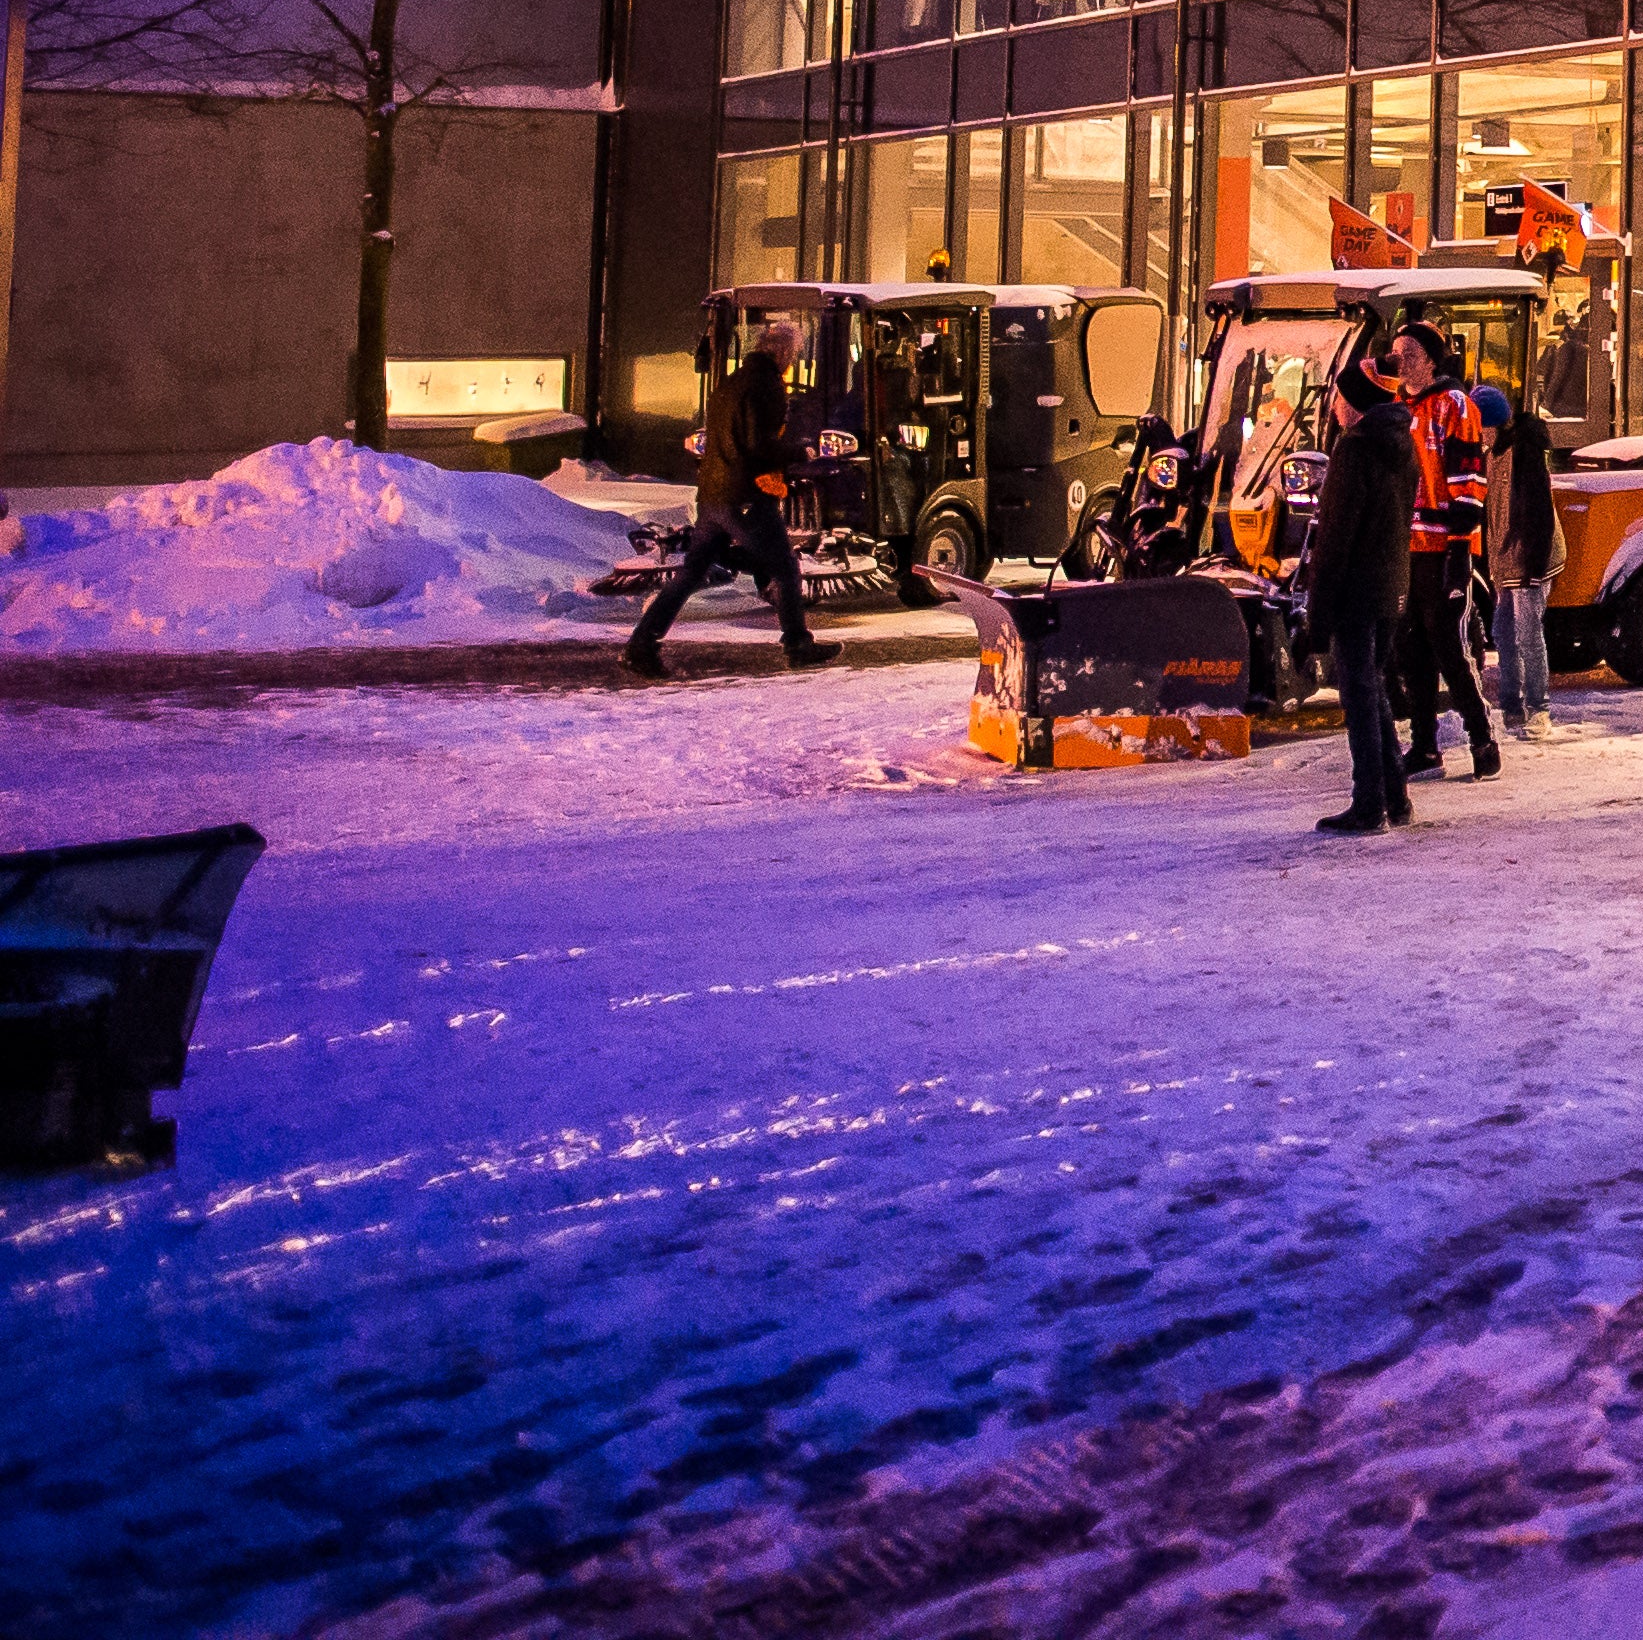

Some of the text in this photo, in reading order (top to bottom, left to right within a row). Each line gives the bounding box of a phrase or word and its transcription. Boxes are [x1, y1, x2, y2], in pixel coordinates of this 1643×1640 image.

[1532, 209, 1575, 227] GAME
[1340, 224, 1377, 241] GAME
[1535, 225, 1572, 239] DY
[1343, 238, 1372, 255] DAY
[1071, 485, 1083, 504] 40
